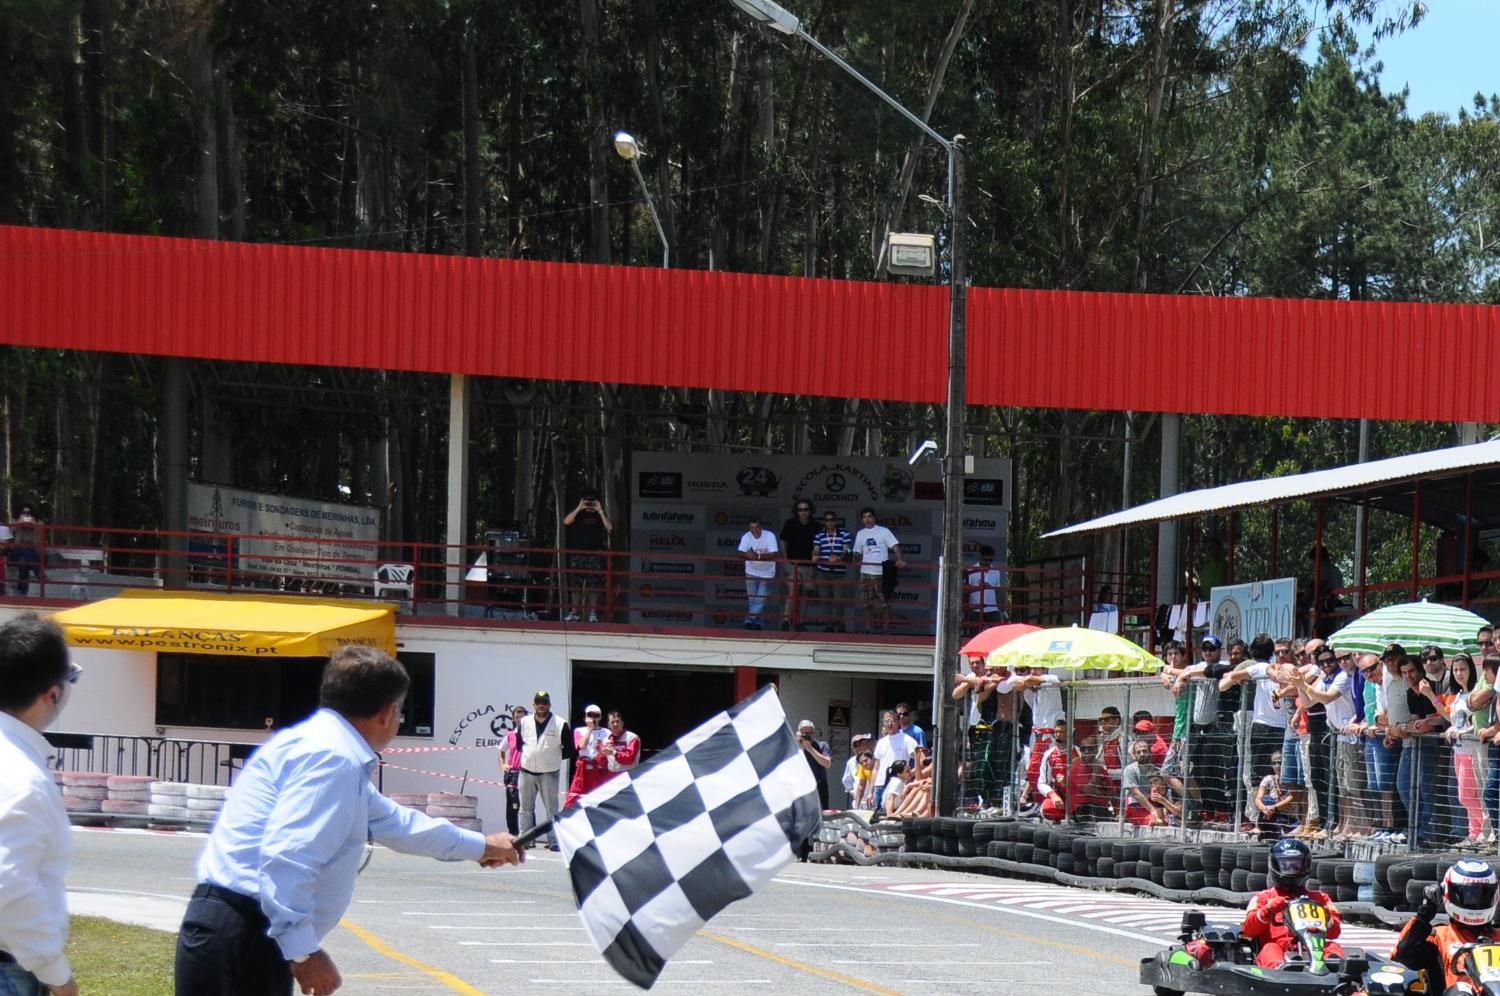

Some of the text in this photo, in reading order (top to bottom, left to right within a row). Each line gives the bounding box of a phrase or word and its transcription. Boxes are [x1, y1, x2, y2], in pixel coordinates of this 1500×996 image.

[687, 480, 728, 489] HONDA
[836, 464, 878, 501] KARTING
[264, 503, 309, 517] SONDAGENS
[74, 637, 280, 655] www.pestronix.pt
[449, 703, 495, 746] ESCOLA
[1296, 904, 1319, 919] 88
